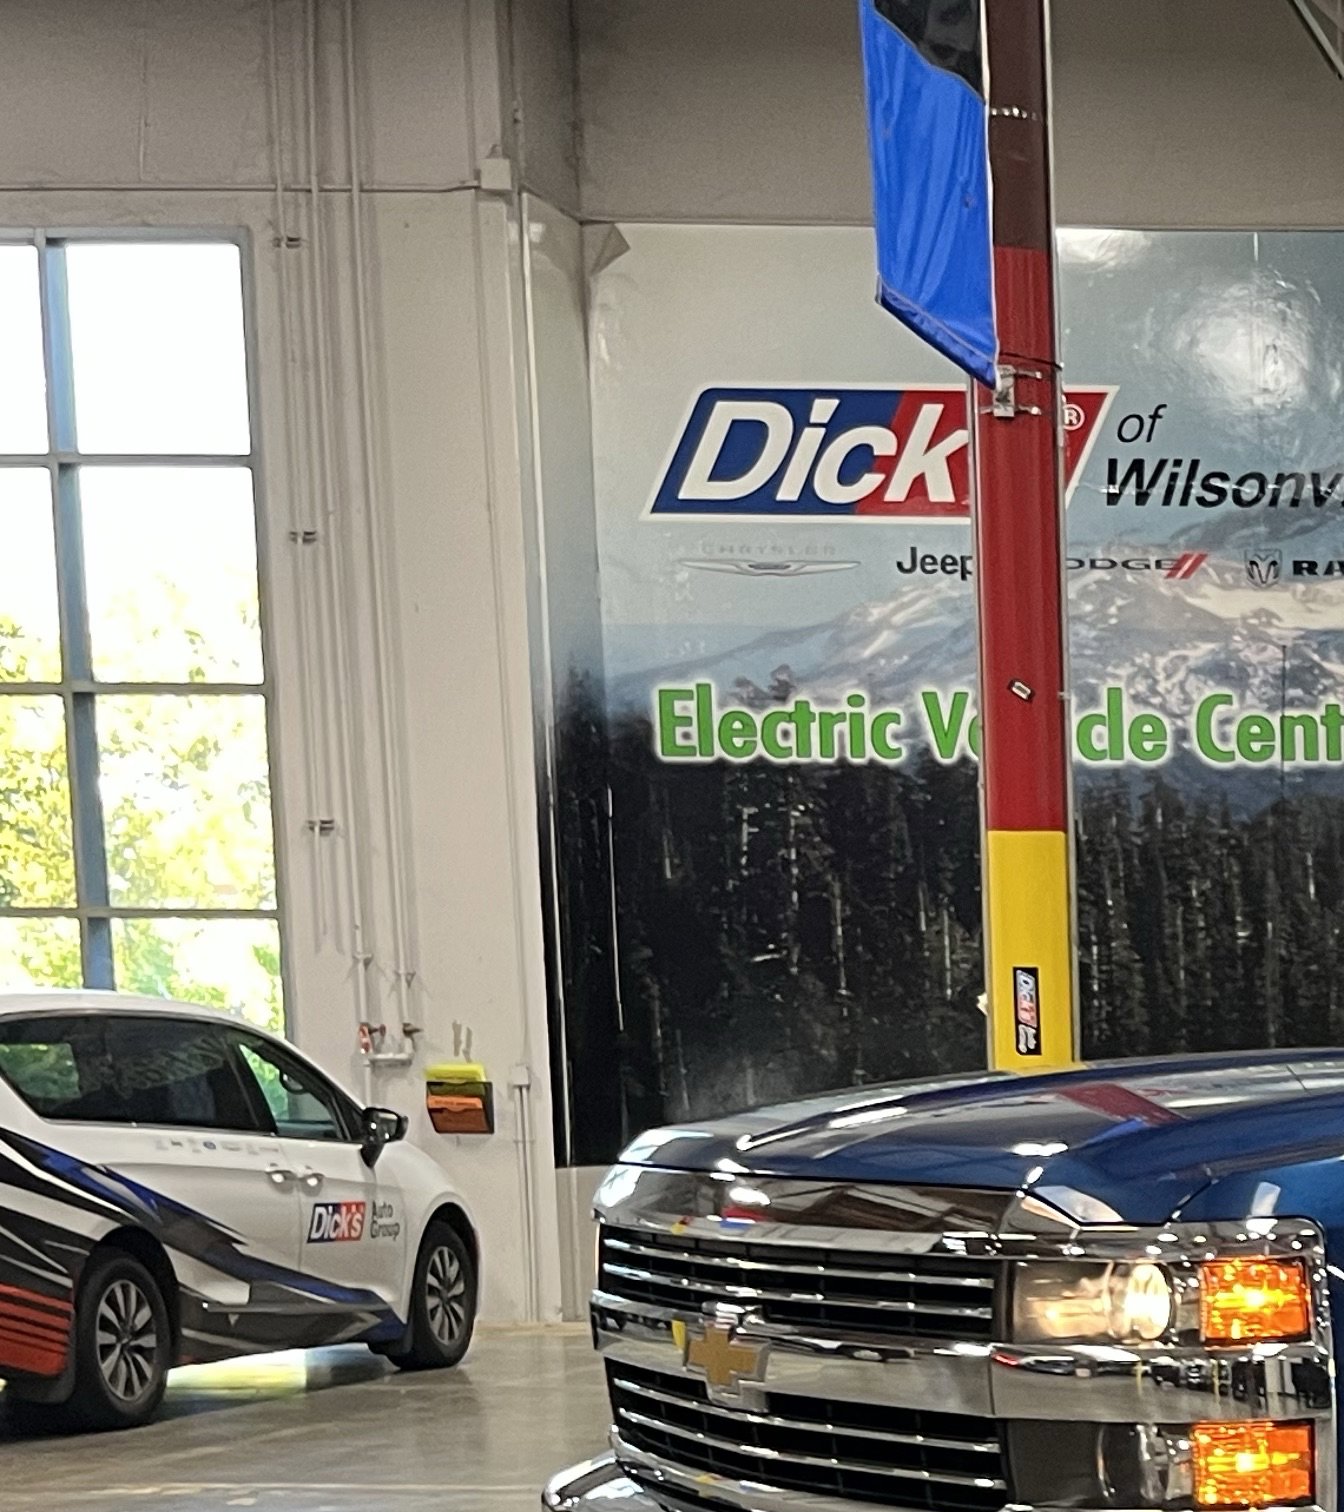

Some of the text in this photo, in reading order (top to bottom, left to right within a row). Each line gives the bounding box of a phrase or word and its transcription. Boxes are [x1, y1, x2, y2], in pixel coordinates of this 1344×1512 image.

[1117, 404, 1167, 443] of
[678, 399, 969, 504] Dick
[1066, 557, 1180, 571] ODGE
[657, 683, 902, 759] Electric
[921, 687, 1168, 761] Vcle
[310, 1203, 363, 1240] Dick's
[372, 1201, 394, 1219] Auto
[370, 1220, 400, 1242] Group
